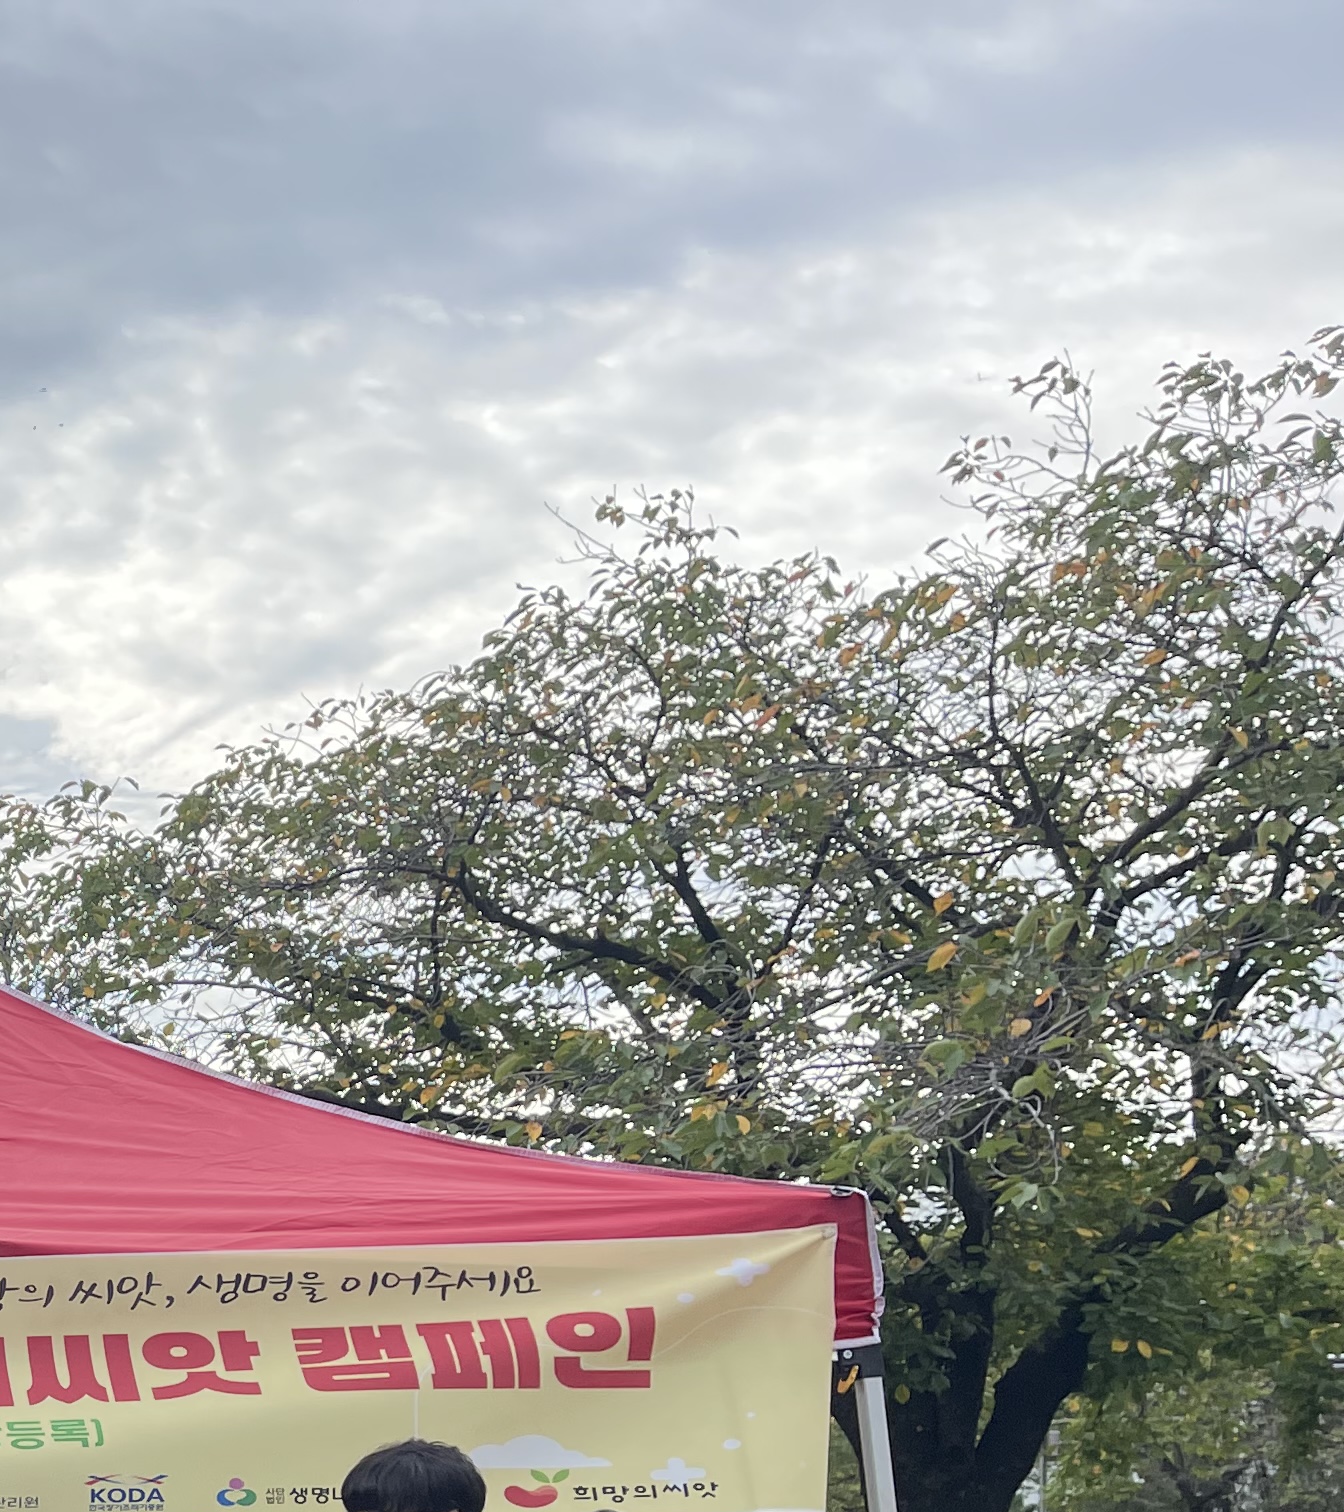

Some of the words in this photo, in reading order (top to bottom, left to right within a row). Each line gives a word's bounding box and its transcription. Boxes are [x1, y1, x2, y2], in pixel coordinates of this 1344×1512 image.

[68, 1272, 175, 1310] 씨앗,
[187, 1271, 327, 1303] 생명을
[340, 1265, 542, 1300] 이어주세요
[292, 1307, 656, 1392] 캠페인
[91, 1488, 165, 1503] KODA
[572, 1481, 719, 1503] 희망의씨앗
